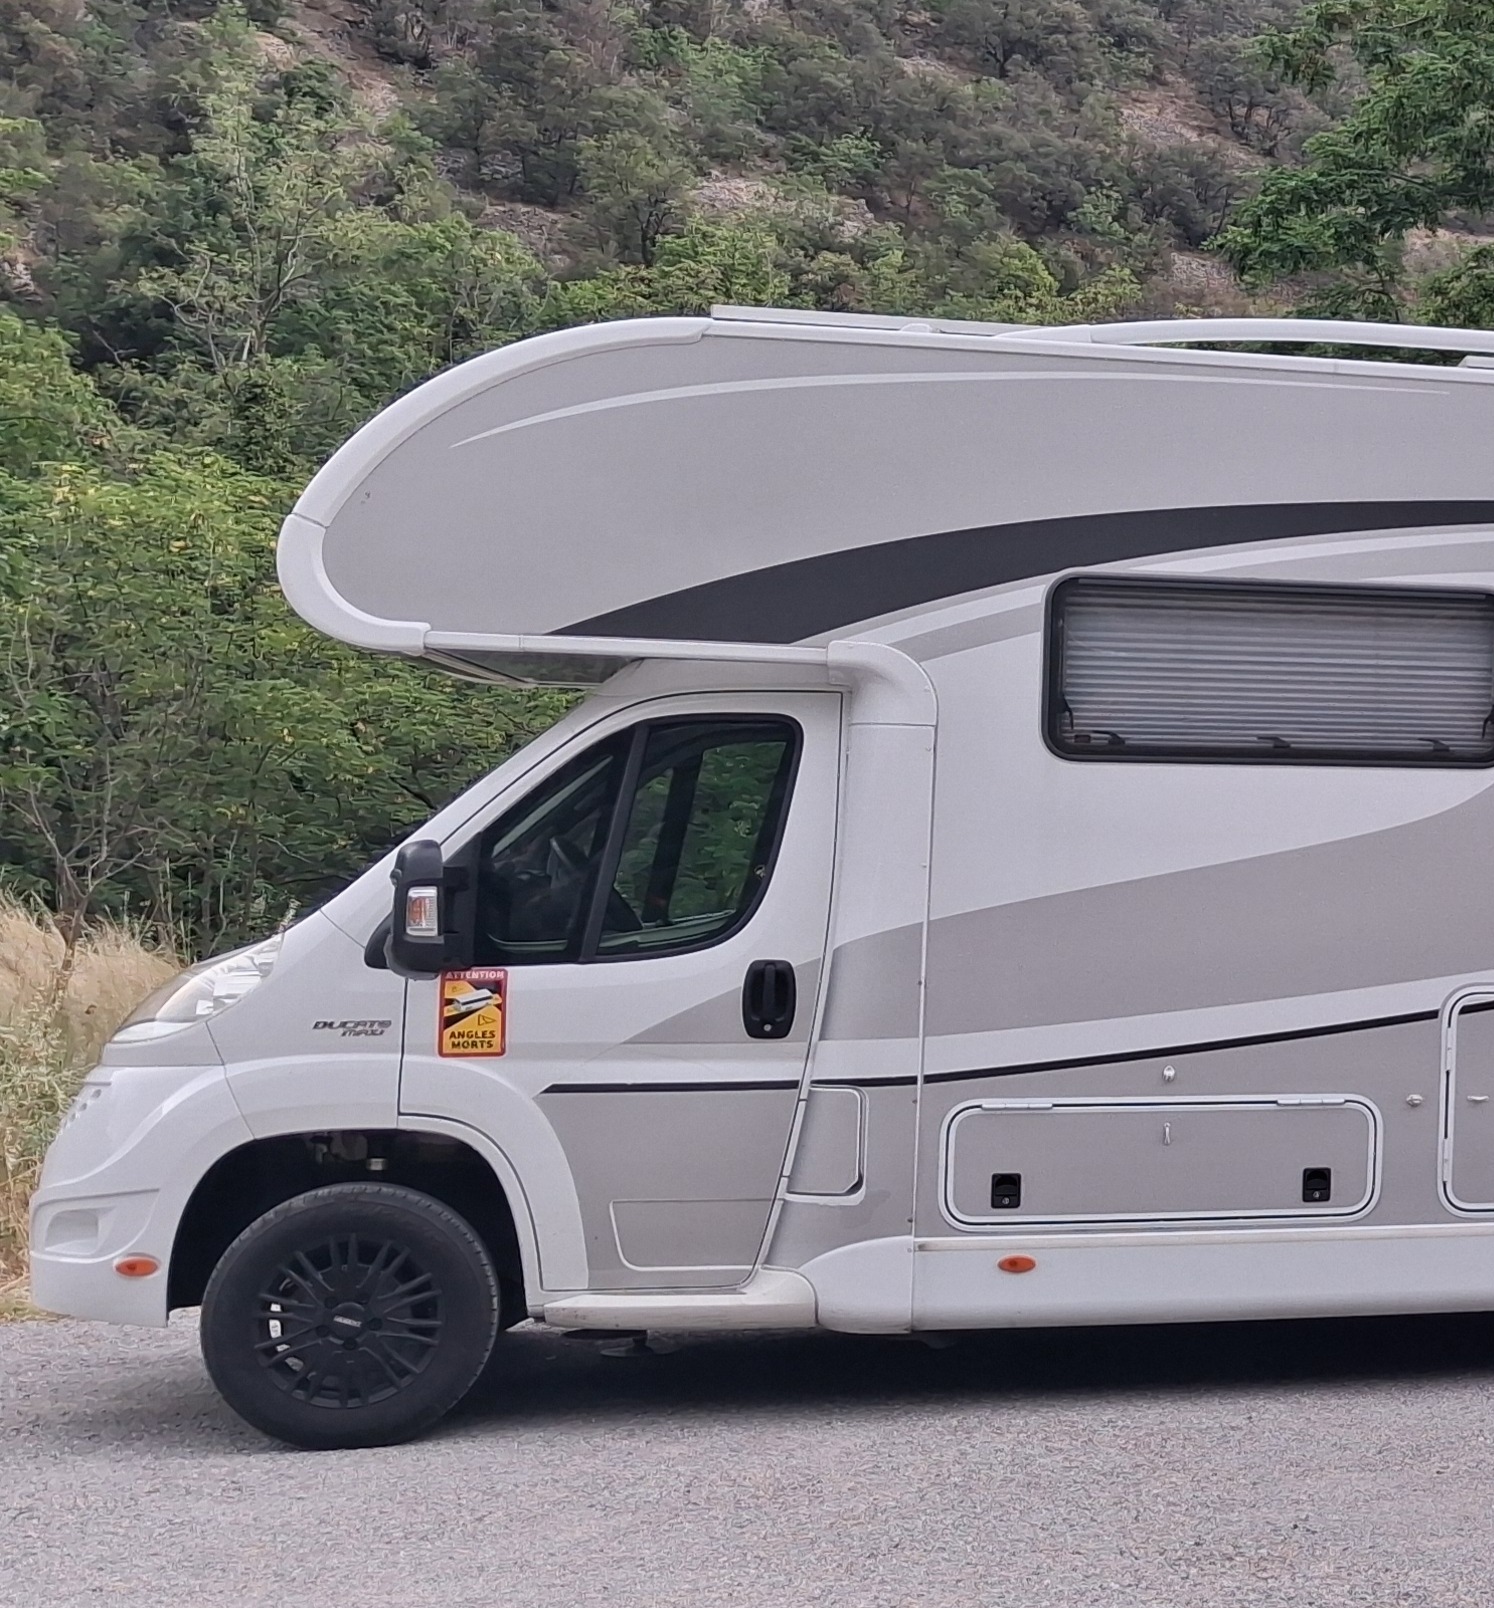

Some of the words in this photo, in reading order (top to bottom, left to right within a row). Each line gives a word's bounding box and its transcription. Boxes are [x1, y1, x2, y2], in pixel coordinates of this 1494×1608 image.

[445, 971, 505, 979] ATTENTION
[312, 1020, 392, 1030] DUCATO
[449, 1030, 496, 1040] ANGLES
[451, 1040, 494, 1049] MORTS
